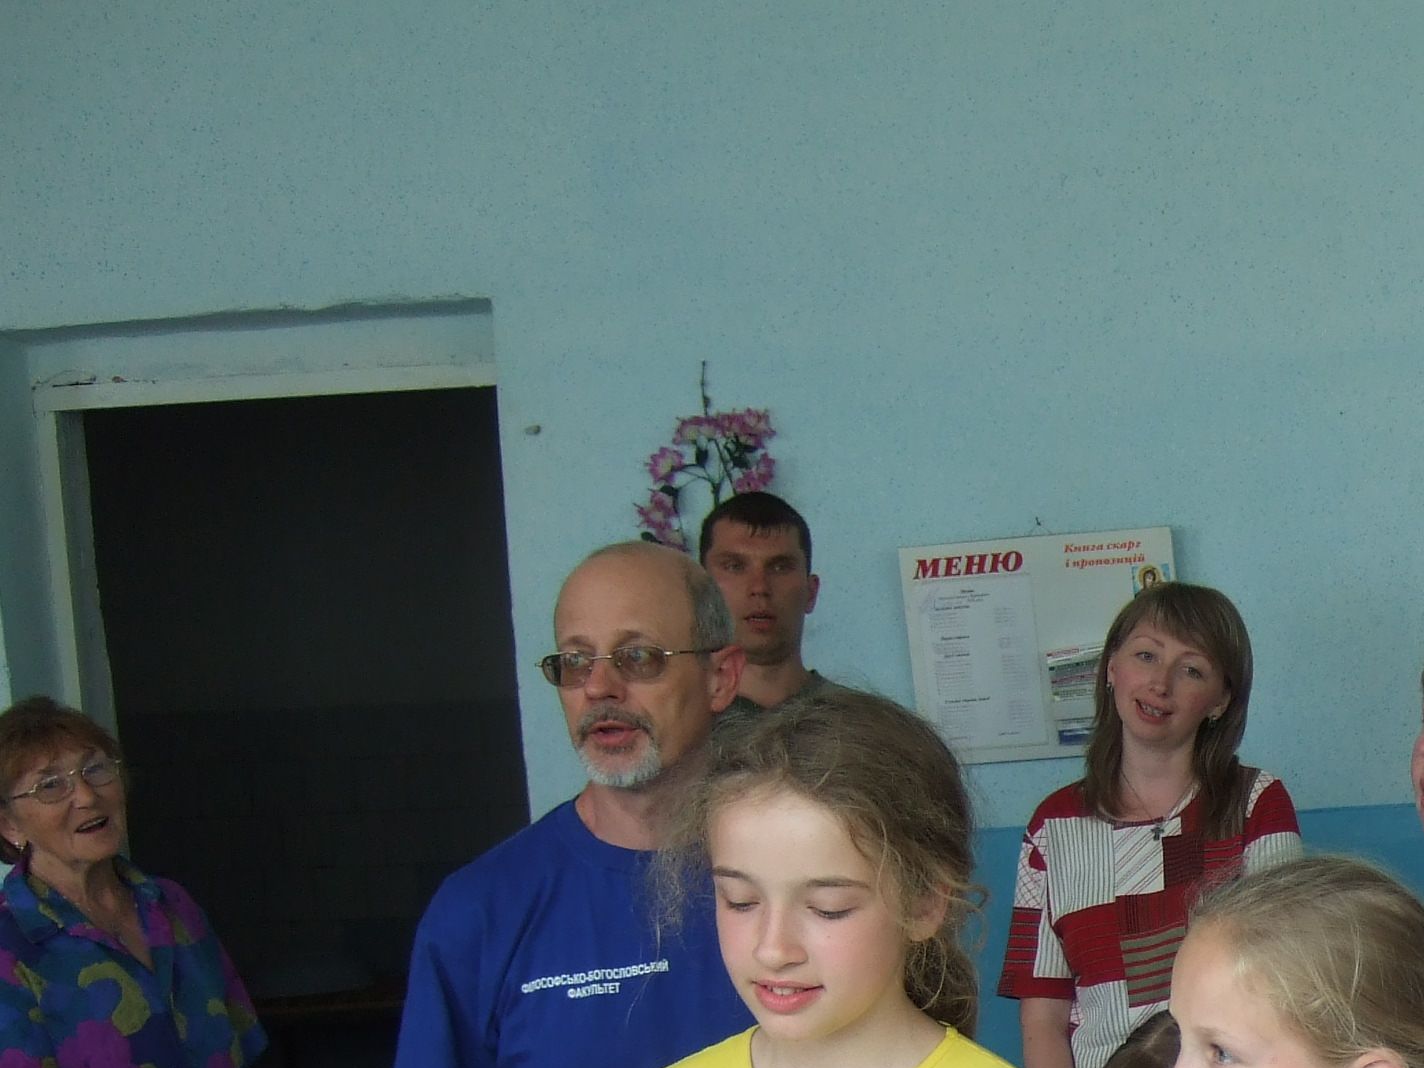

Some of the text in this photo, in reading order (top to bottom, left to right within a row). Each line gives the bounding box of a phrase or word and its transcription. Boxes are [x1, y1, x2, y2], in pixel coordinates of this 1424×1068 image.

[1064, 540, 1141, 553] Книга скарг
[912, 549, 1024, 580] МЕНЮ
[566, 982, 621, 999] ФАКУЛЬТЕТ
